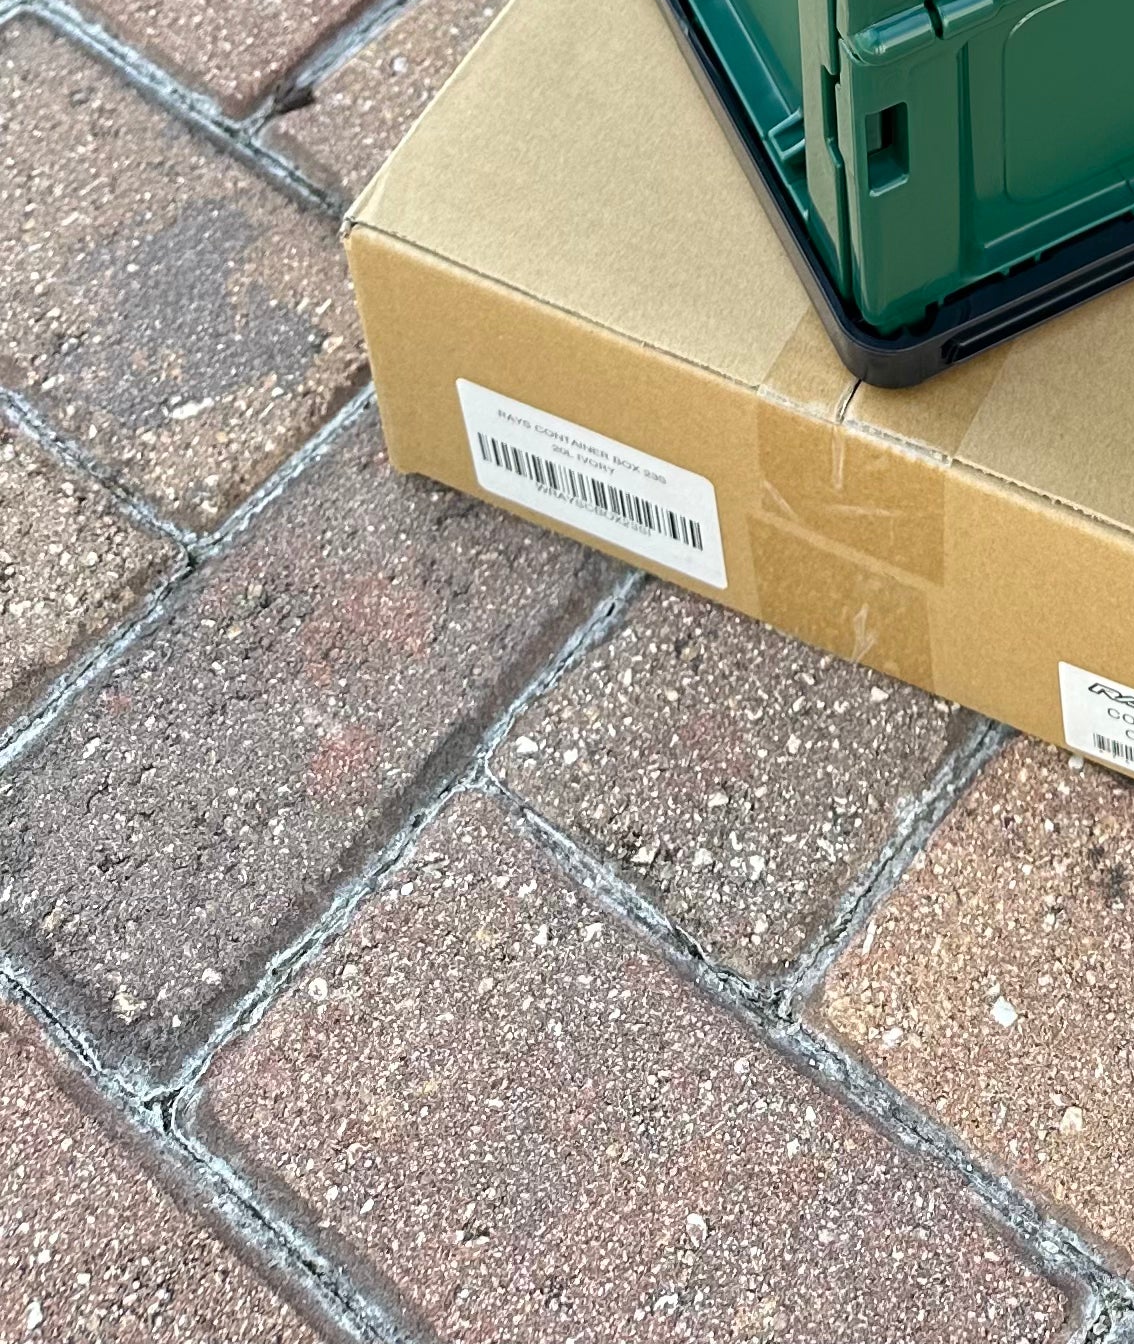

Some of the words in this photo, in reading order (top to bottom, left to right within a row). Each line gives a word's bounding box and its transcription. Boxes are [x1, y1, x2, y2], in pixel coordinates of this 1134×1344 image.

[498, 408, 532, 430] RAYS
[534, 424, 610, 460] CONTAINER
[612, 454, 641, 474] BOX
[576, 452, 616, 476] IVORY
